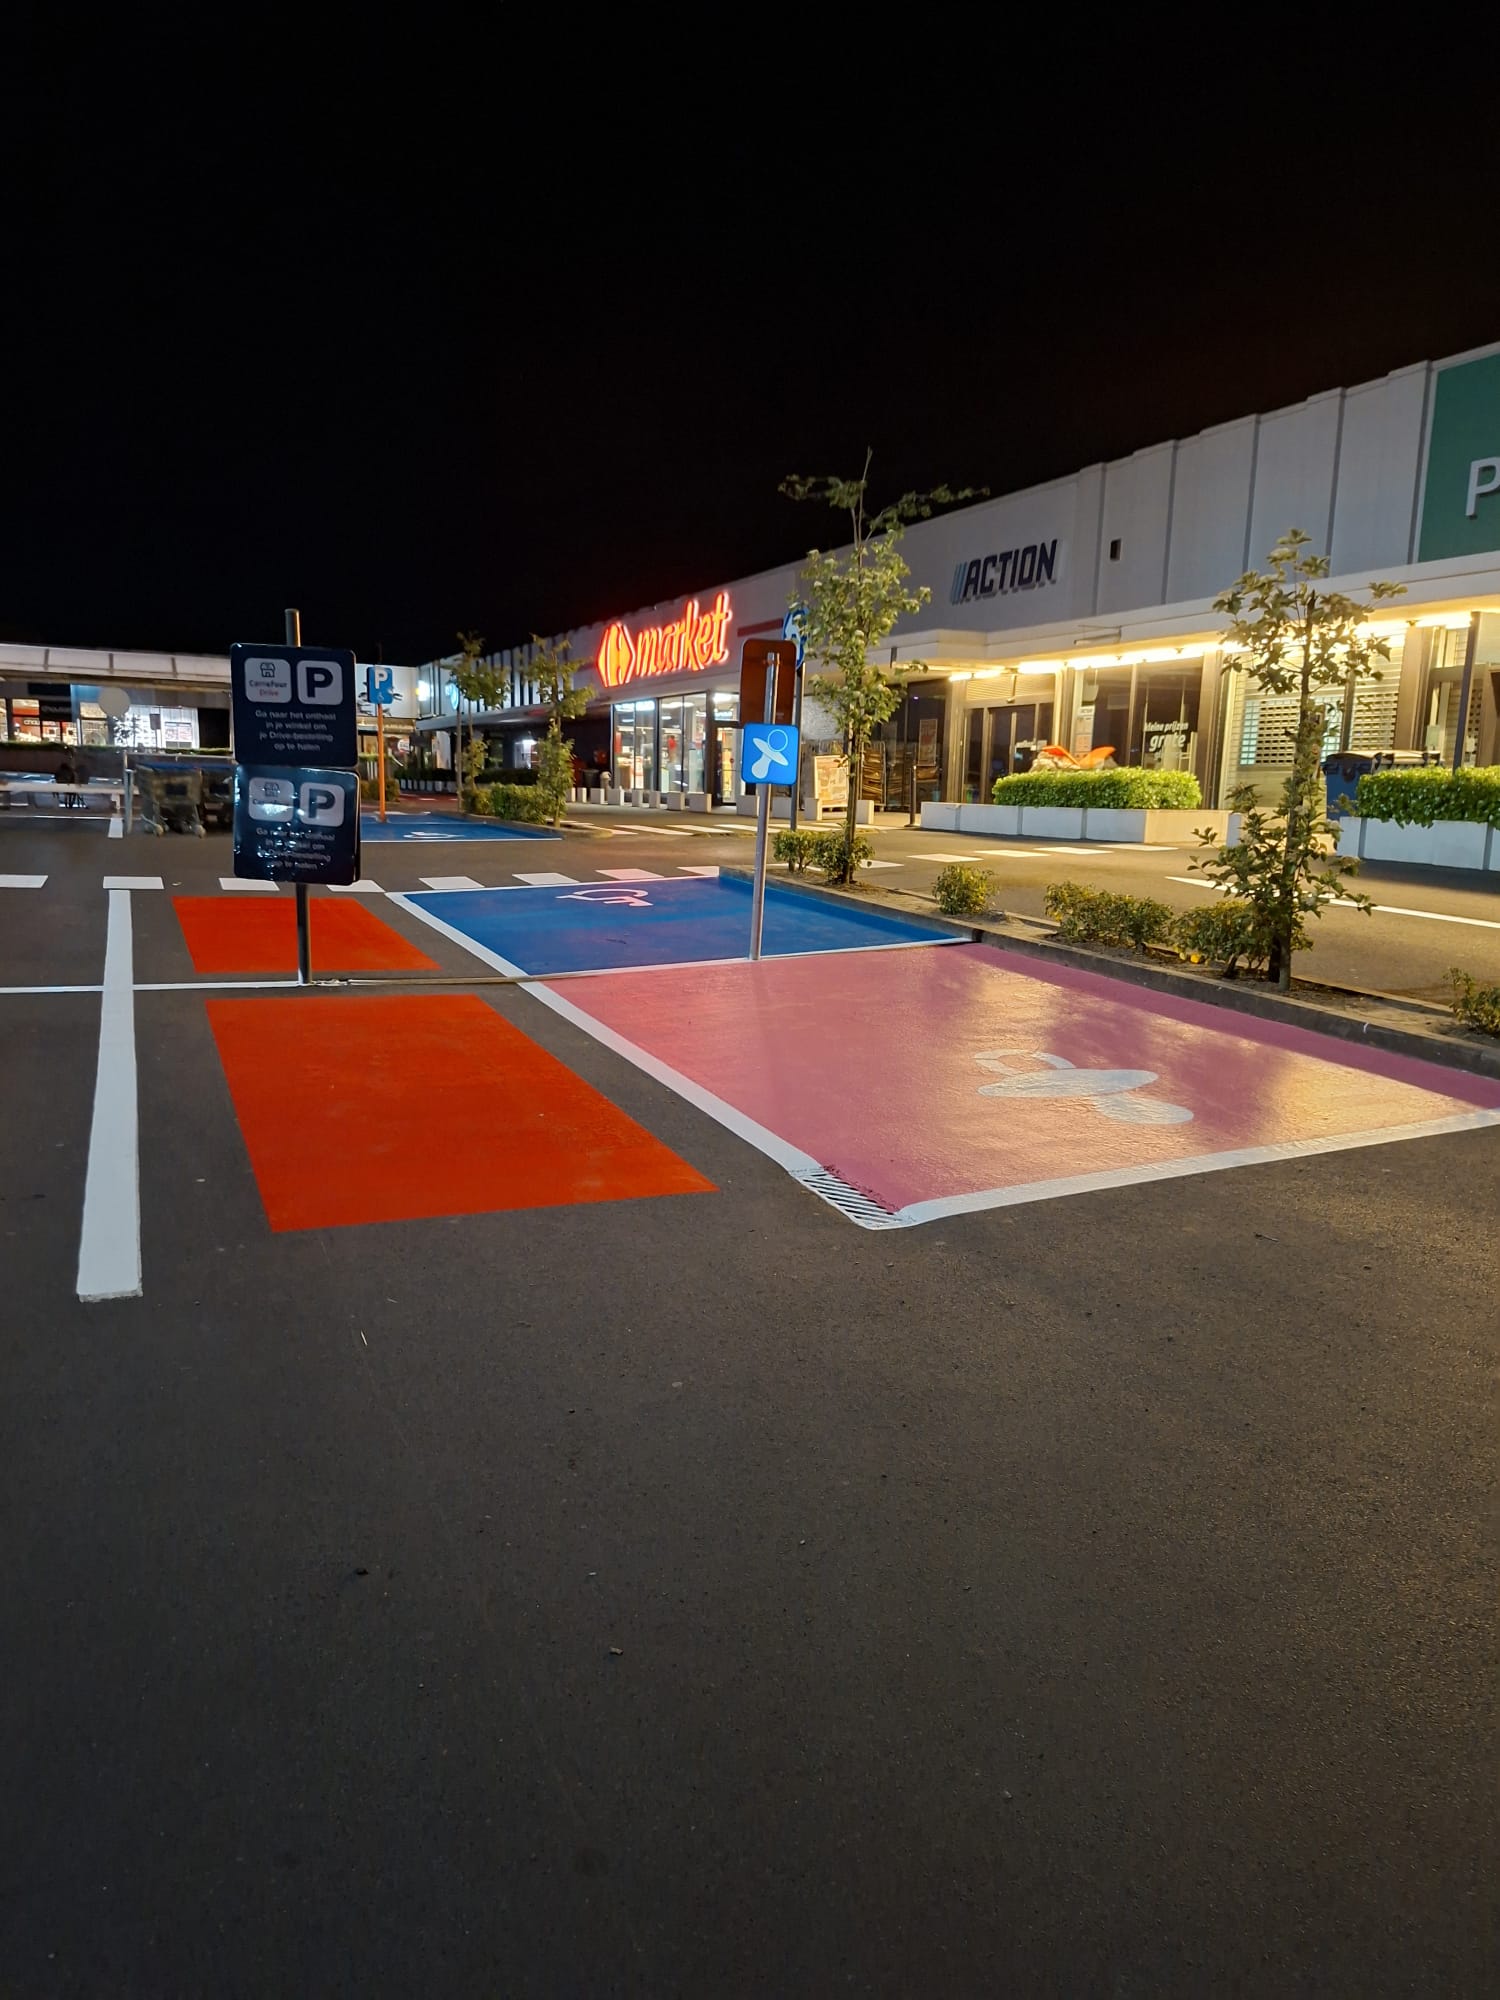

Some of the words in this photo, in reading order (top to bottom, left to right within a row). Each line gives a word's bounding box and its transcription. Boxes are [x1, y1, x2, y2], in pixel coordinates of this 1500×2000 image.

[962, 539, 1058, 598] ACTION
[635, 591, 730, 675] market
[249, 680, 287, 688] Carrefour
[306, 667, 333, 698] P
[375, 665, 388, 690] P
[255, 710, 267, 718] Ga
[269, 711, 288, 719] naar
[290, 711, 304, 719] het
[285, 721, 311, 730] winkel
[313, 723, 327, 731] om
[309, 788, 335, 818] P
[270, 829, 288, 837] nar
